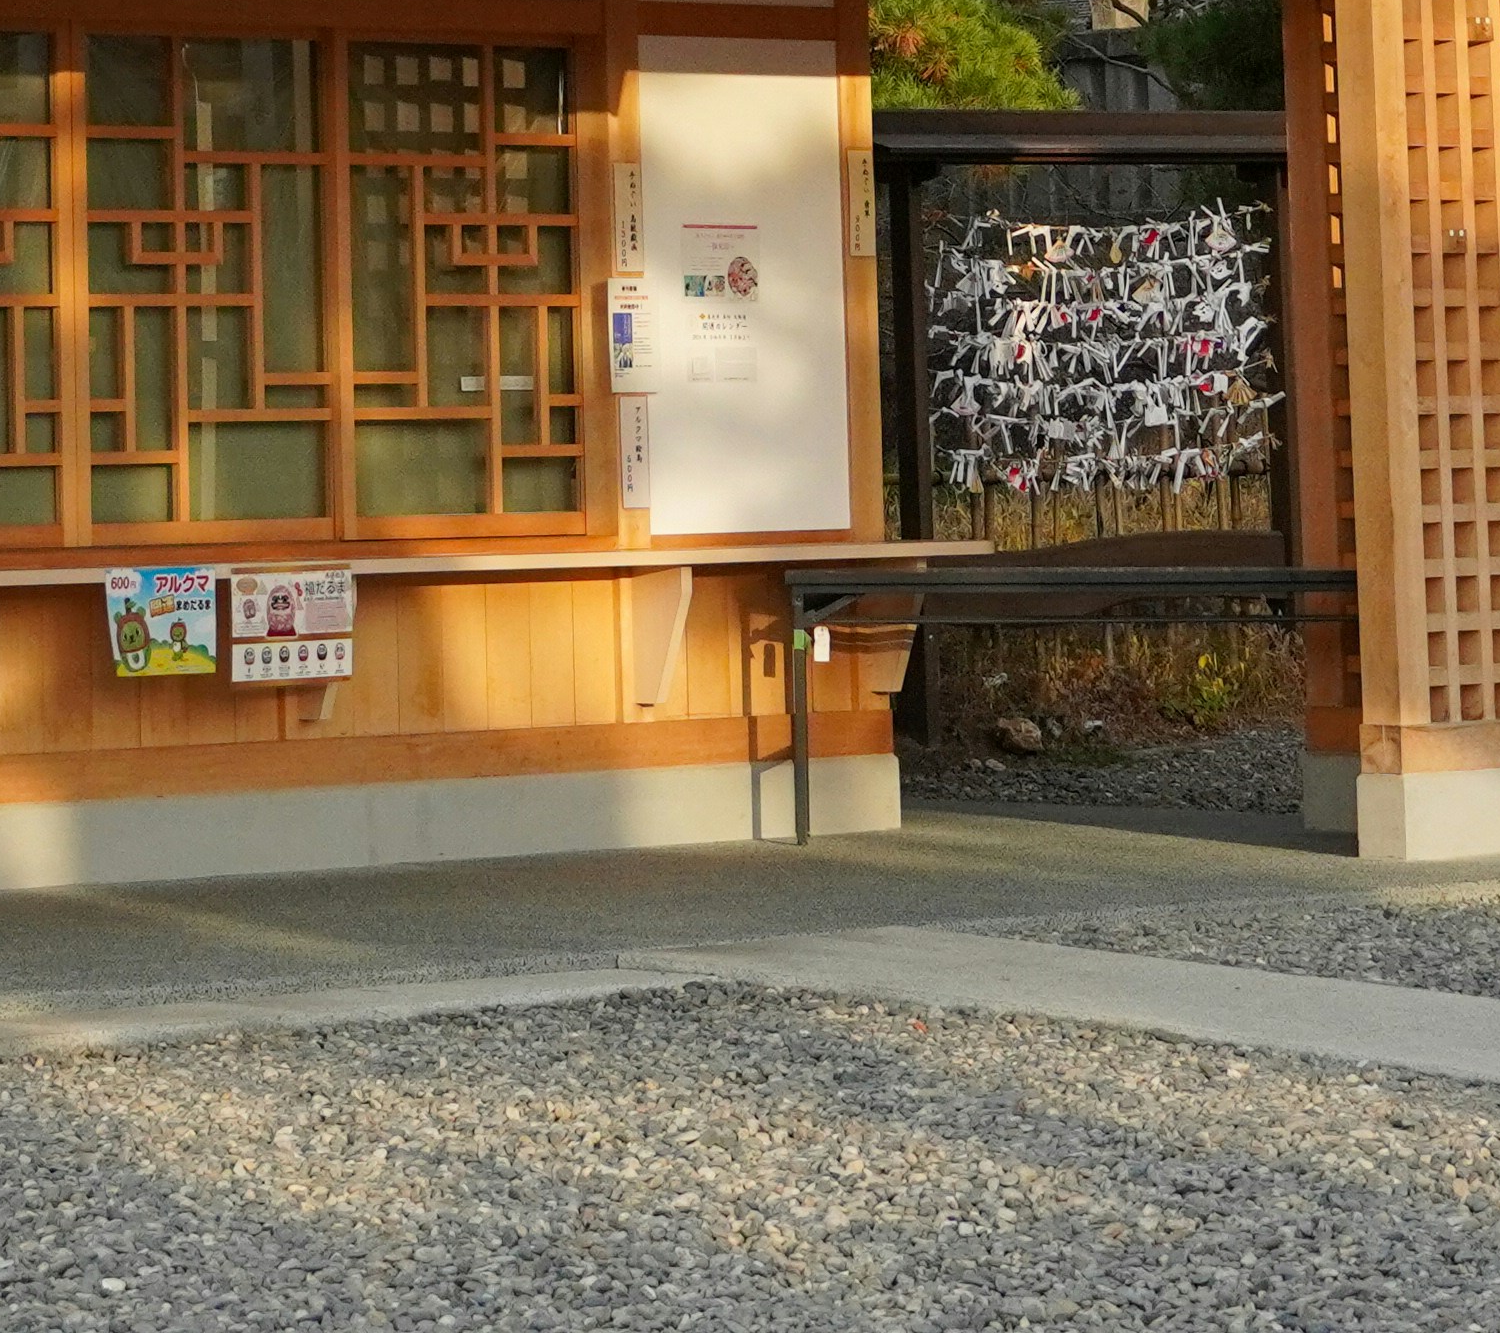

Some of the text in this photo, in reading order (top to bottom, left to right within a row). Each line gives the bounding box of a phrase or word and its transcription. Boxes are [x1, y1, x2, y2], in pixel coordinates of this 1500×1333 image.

[110, 573, 210, 594] 600円 アルクマ
